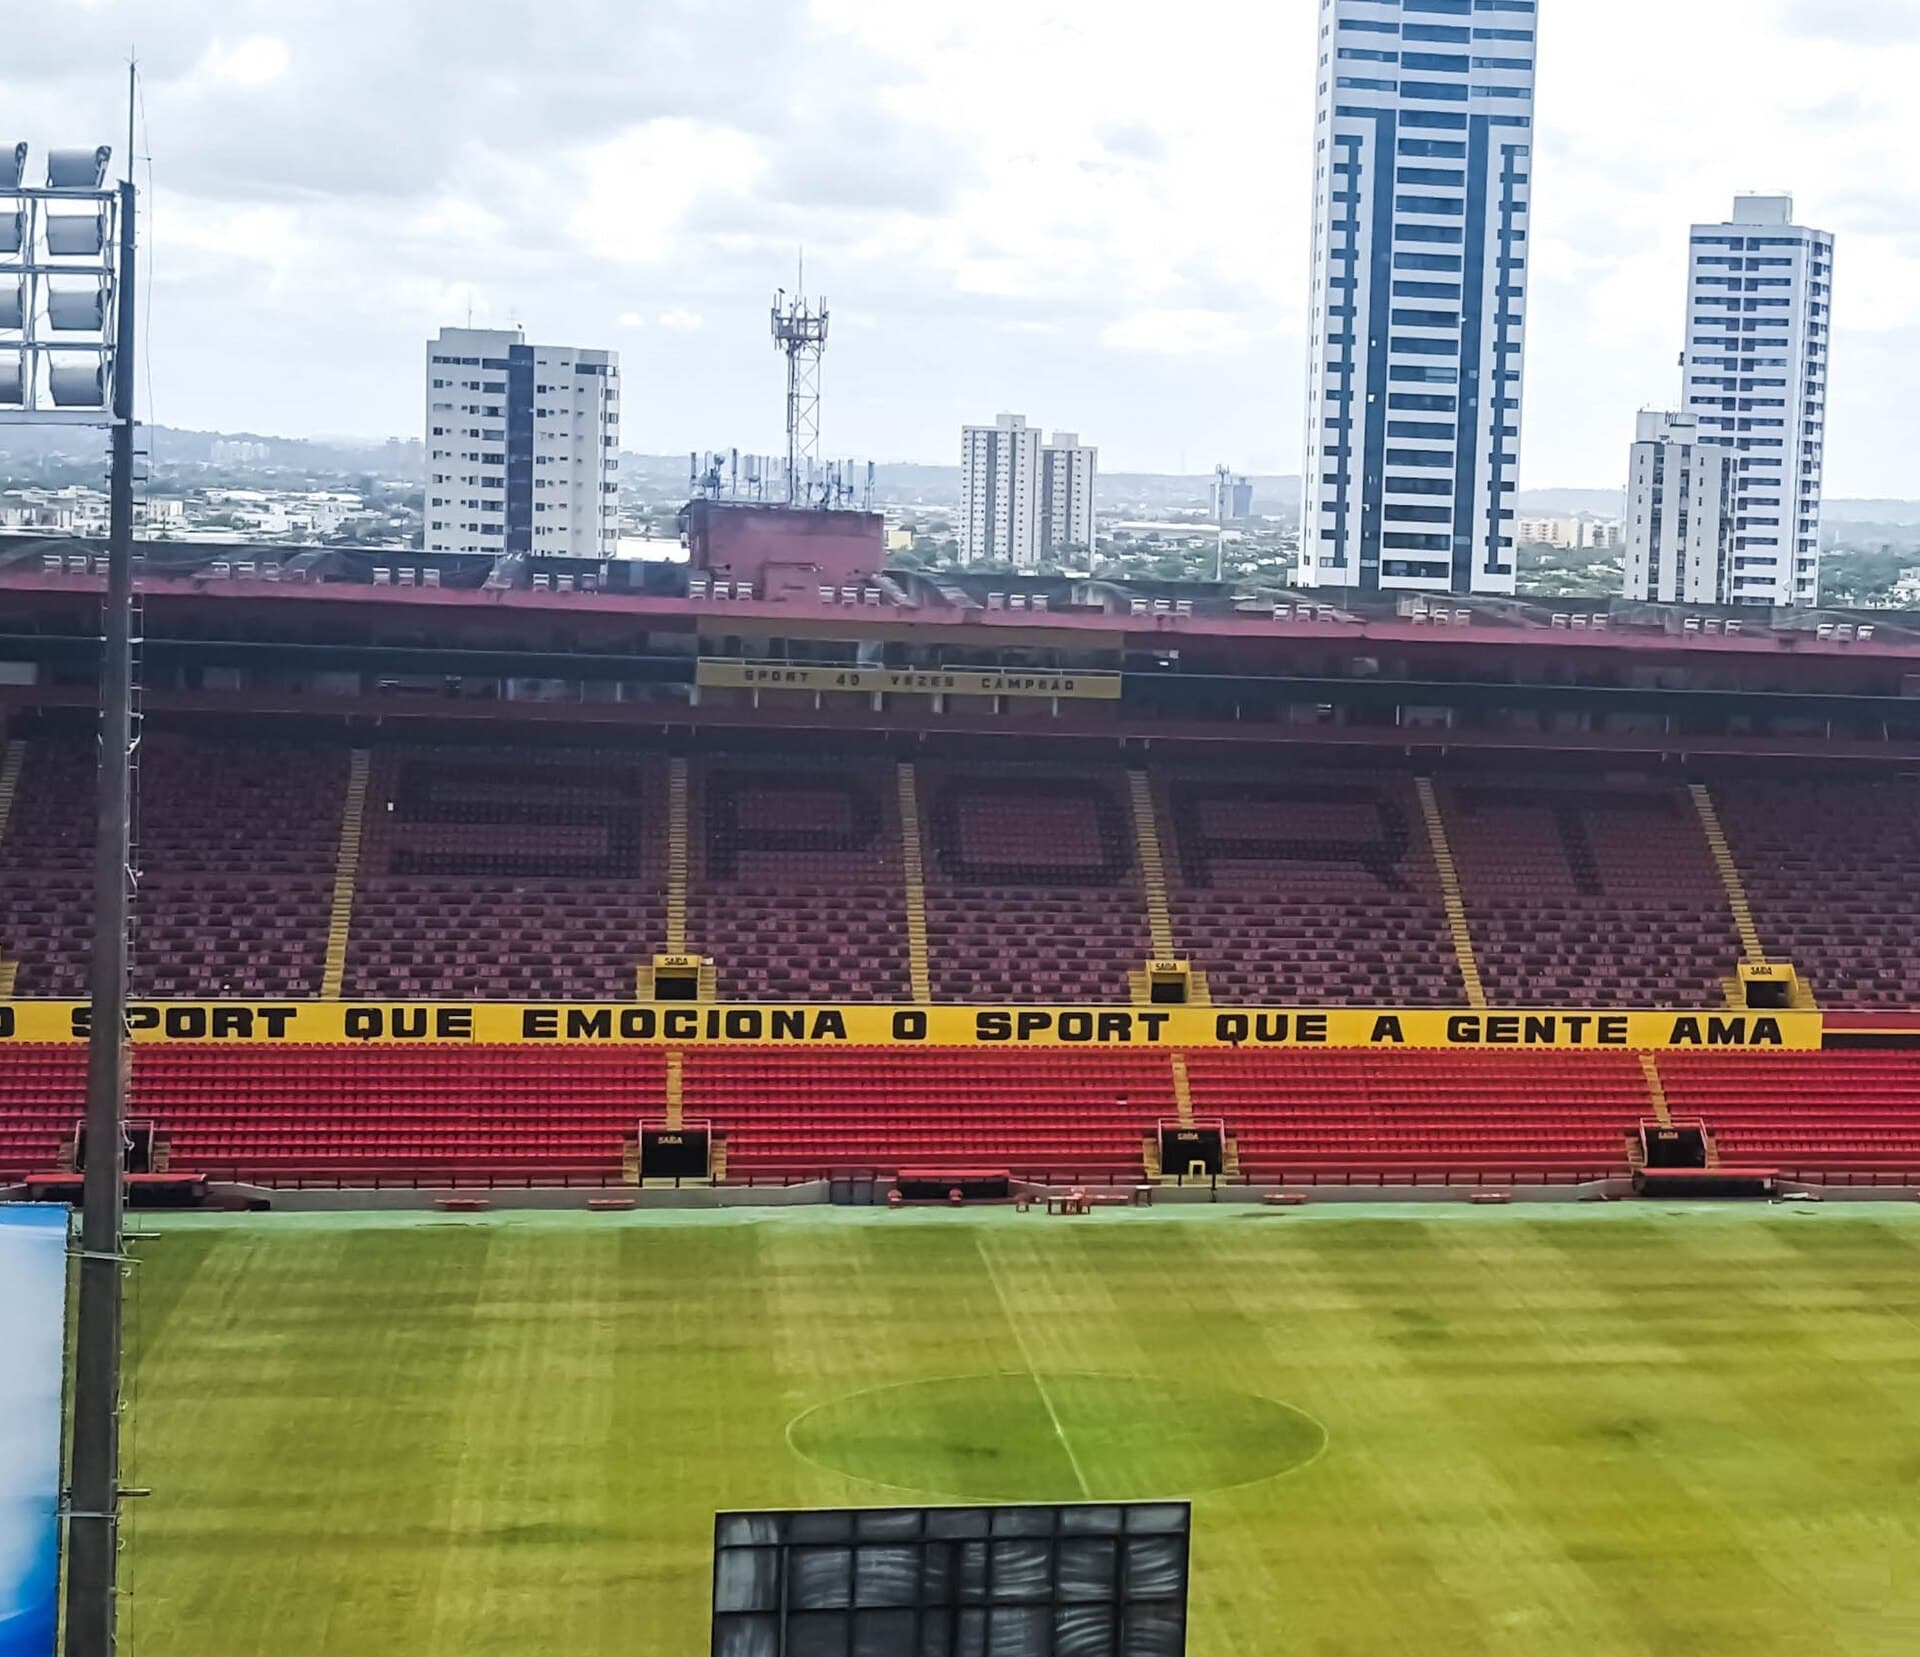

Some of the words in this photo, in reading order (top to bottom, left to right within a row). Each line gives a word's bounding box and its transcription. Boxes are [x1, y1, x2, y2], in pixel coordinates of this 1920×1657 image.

[745, 670, 809, 684] SPORT
[344, 1007, 472, 1041] QUE
[522, 1008, 847, 1040] EMOCIONA
[892, 1010, 927, 1040] O
[976, 1011, 1170, 1042] SPORT
[1215, 1013, 1327, 1046] QUE
[1371, 1015, 1404, 1042] A
[1446, 1015, 1628, 1044] GENTE
[1669, 1016, 1783, 1045] AMA
